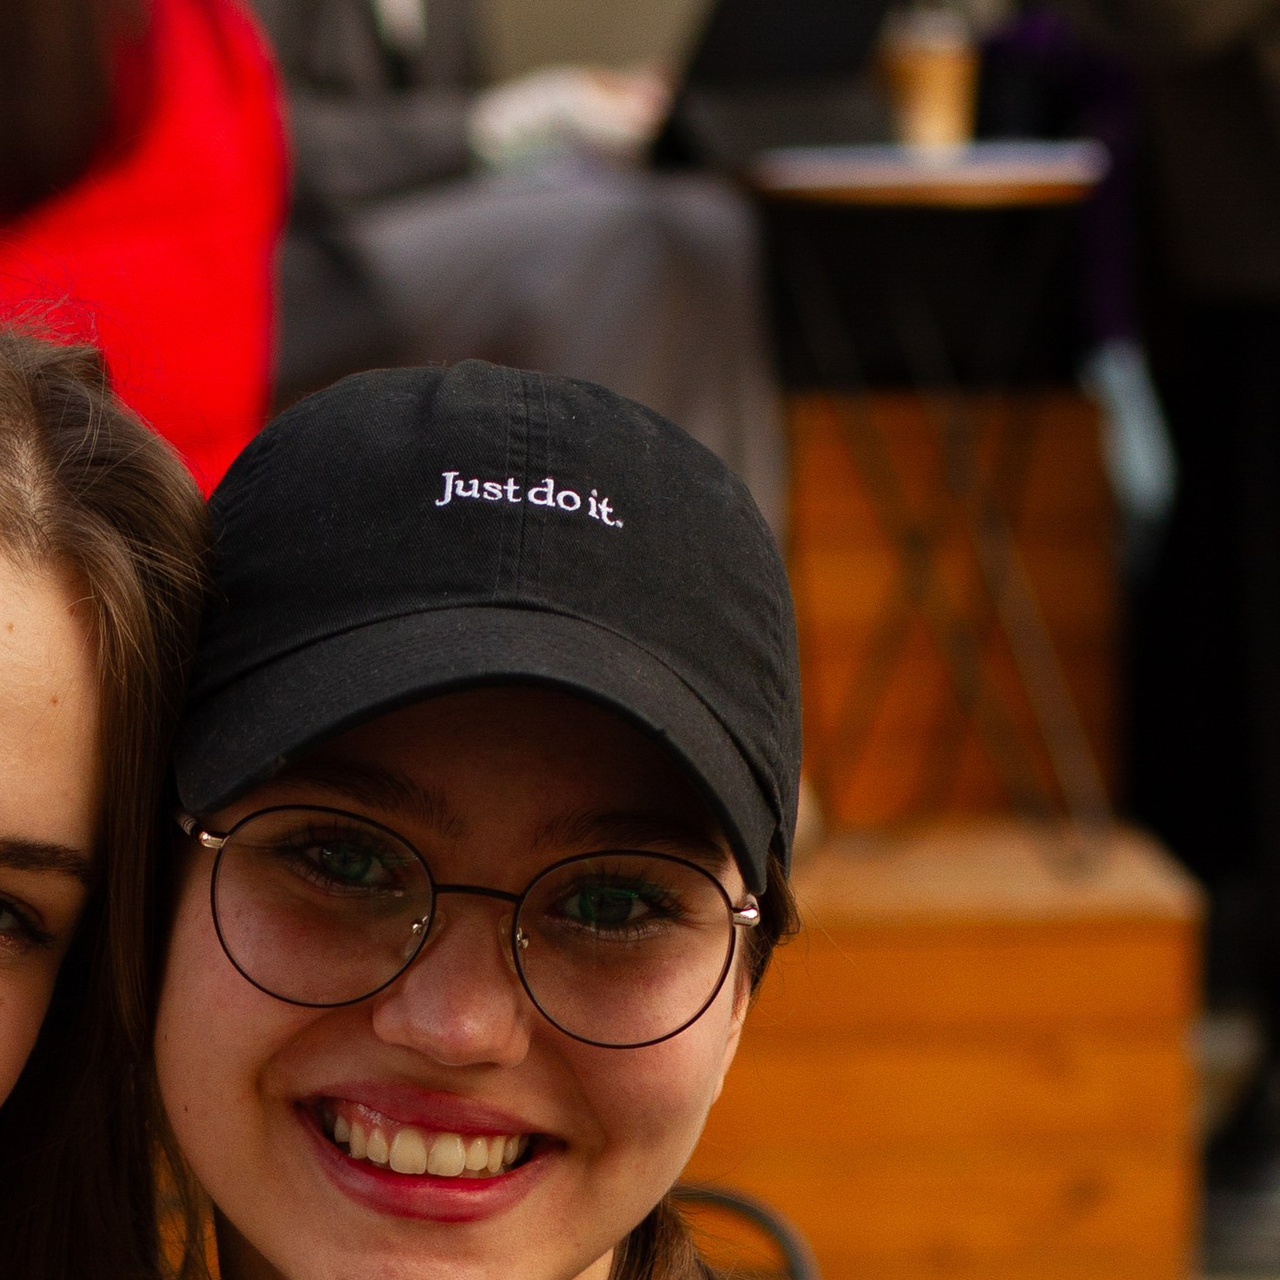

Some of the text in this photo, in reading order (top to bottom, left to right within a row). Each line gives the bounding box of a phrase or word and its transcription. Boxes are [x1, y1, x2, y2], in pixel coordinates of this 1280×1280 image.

[434, 470, 624, 529] Just do it.
